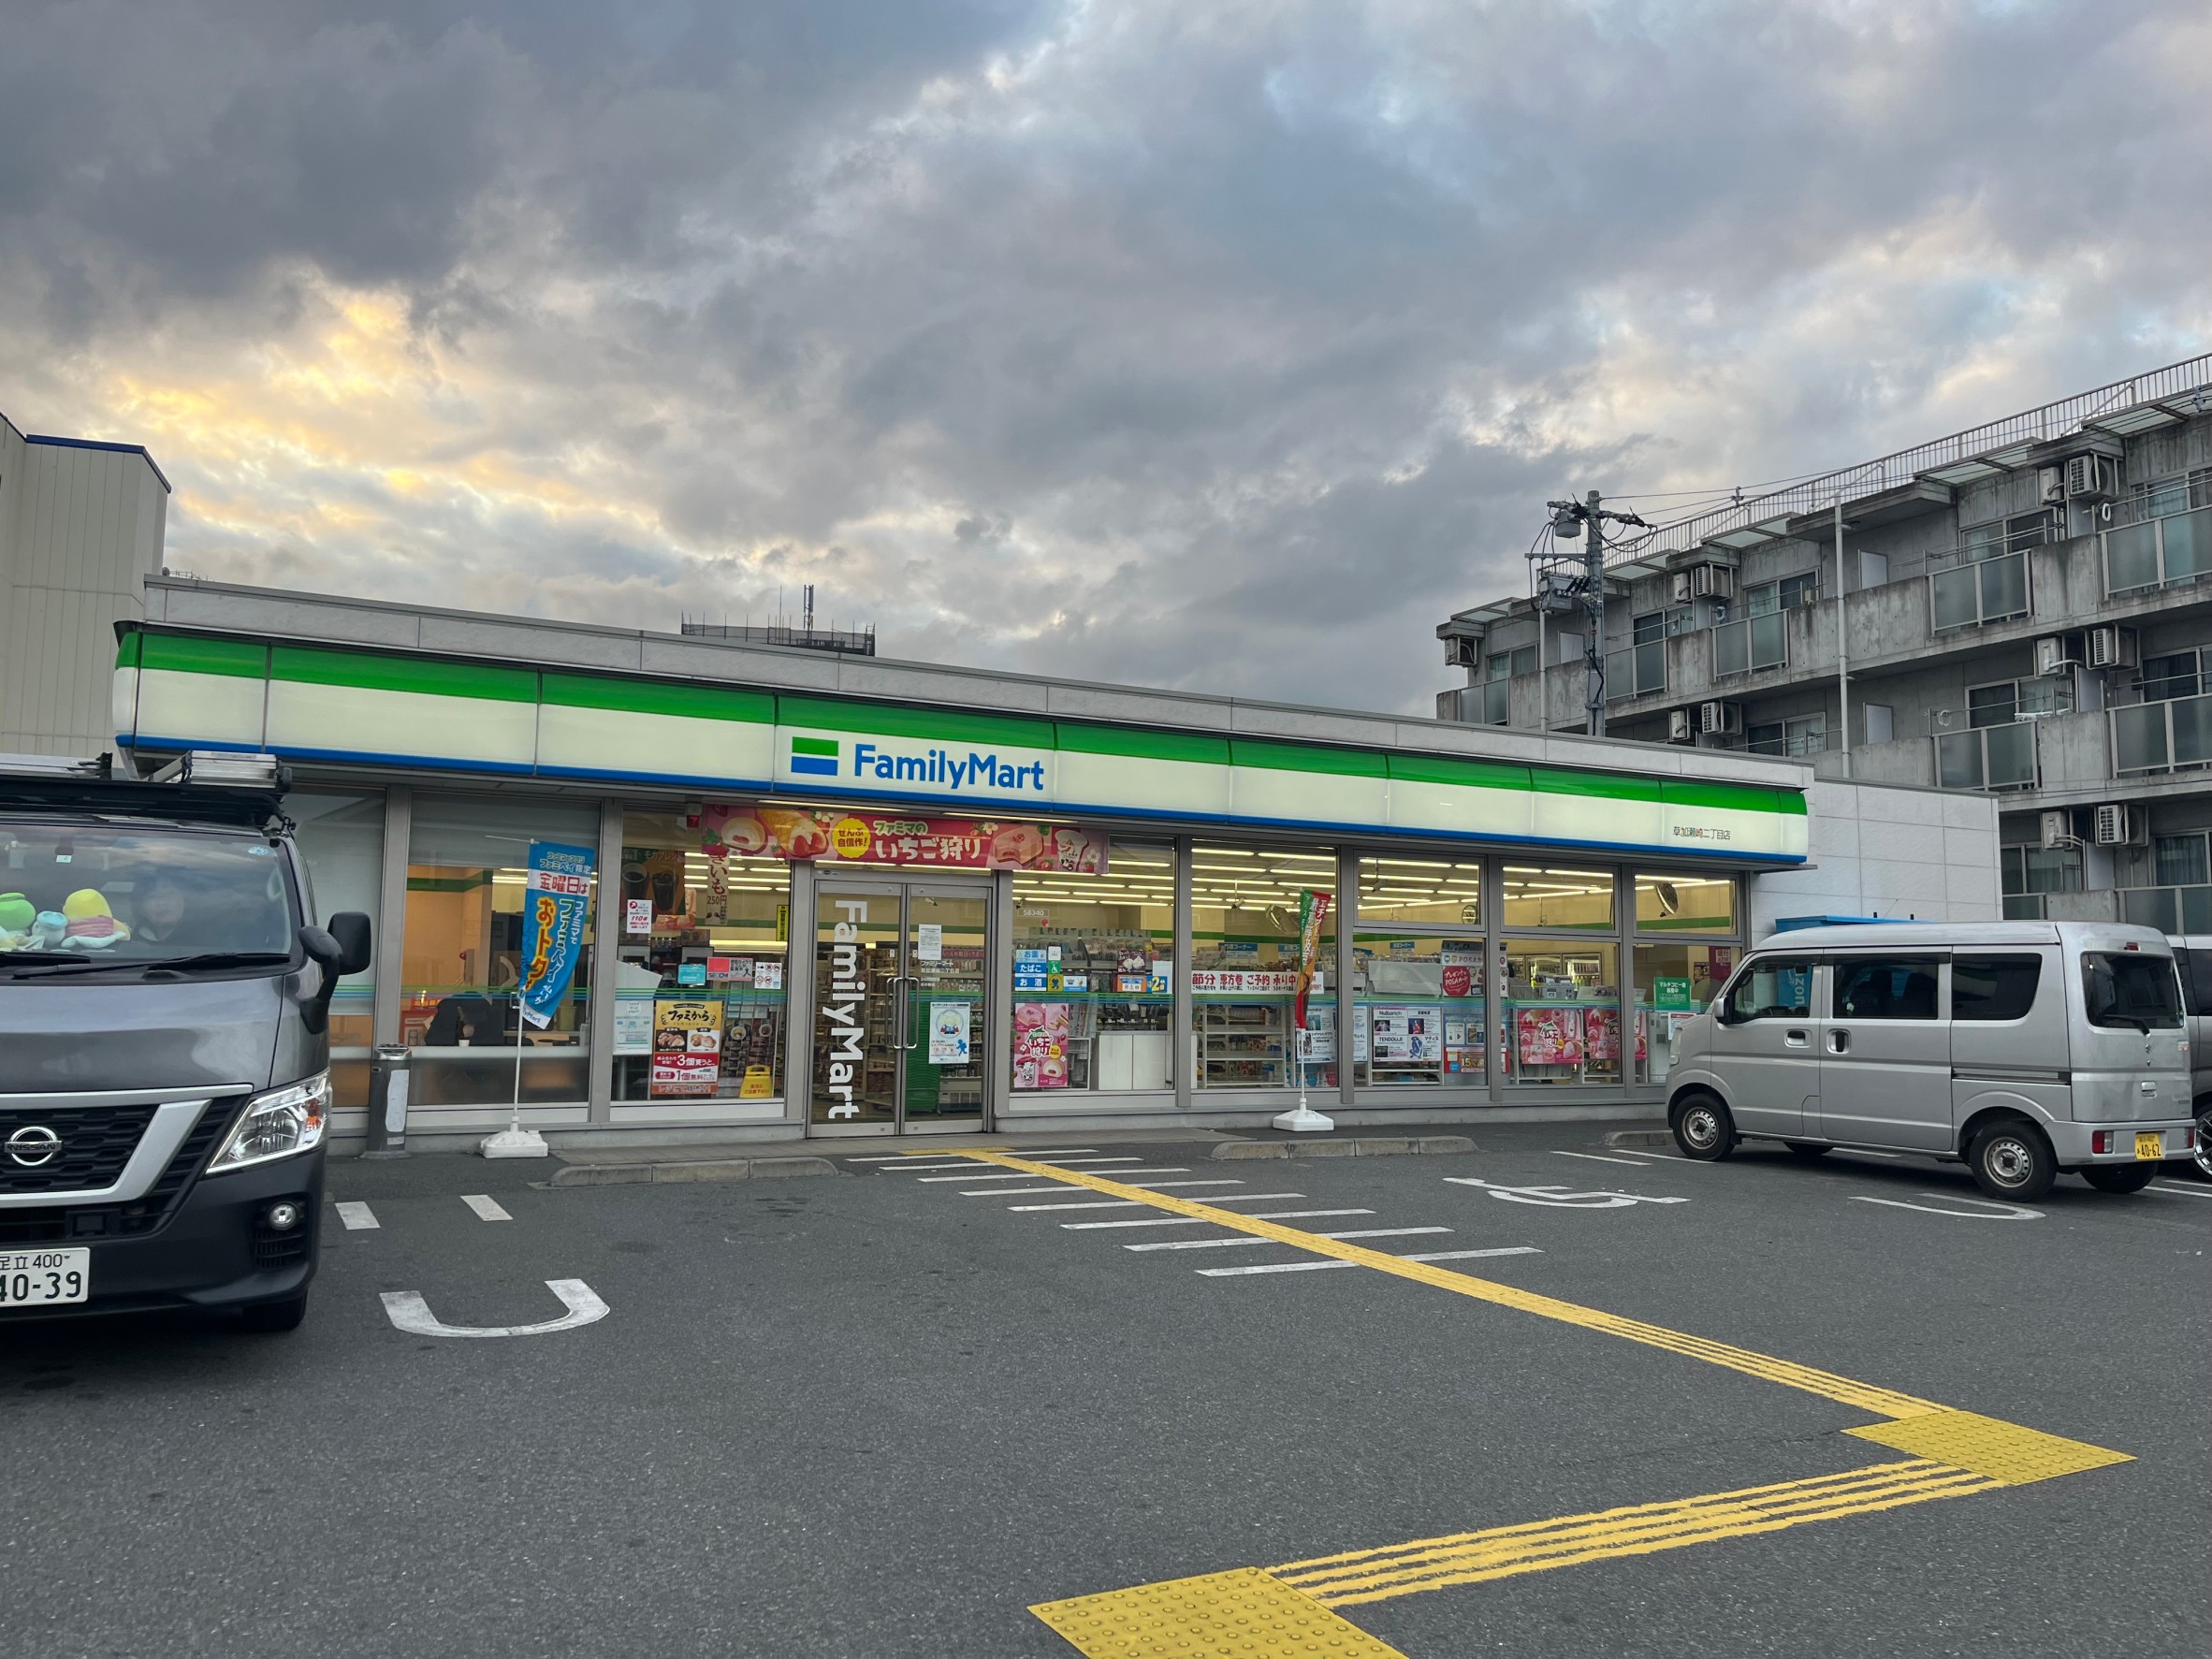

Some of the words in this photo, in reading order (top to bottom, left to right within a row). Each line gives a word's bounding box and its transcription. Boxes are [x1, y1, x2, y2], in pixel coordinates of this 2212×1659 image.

[854, 744, 1044, 791] FamilyMart
[837, 828, 864, 837] ぜんぶ
[874, 820, 928, 836] ファミマの
[1673, 825, 1731, 840] 草加瀬崎二丁目店
[837, 837, 867, 848] 自信作!
[875, 836, 981, 861] いちご狩り
[540, 859, 592, 875] ファミペイ限定
[540, 872, 589, 895] 金曜日は
[707, 895, 727, 905] 250円
[1019, 964, 1042, 973] たばこ
[1192, 973, 1215, 985] 節分
[1219, 974, 1243, 985] 恵方巻
[1246, 974, 1271, 985] ご予約
[1273, 974, 1296, 985] 承り中
[1795, 973, 1805, 1005] zon
[667, 1010, 709, 1022] ファミから
[822, 900, 868, 1119] FamilyMart
[8, 1143, 56, 1152] NISSAN
[0, 1256, 29, 1271] 足立
[33, 1254, 63, 1269] 400
